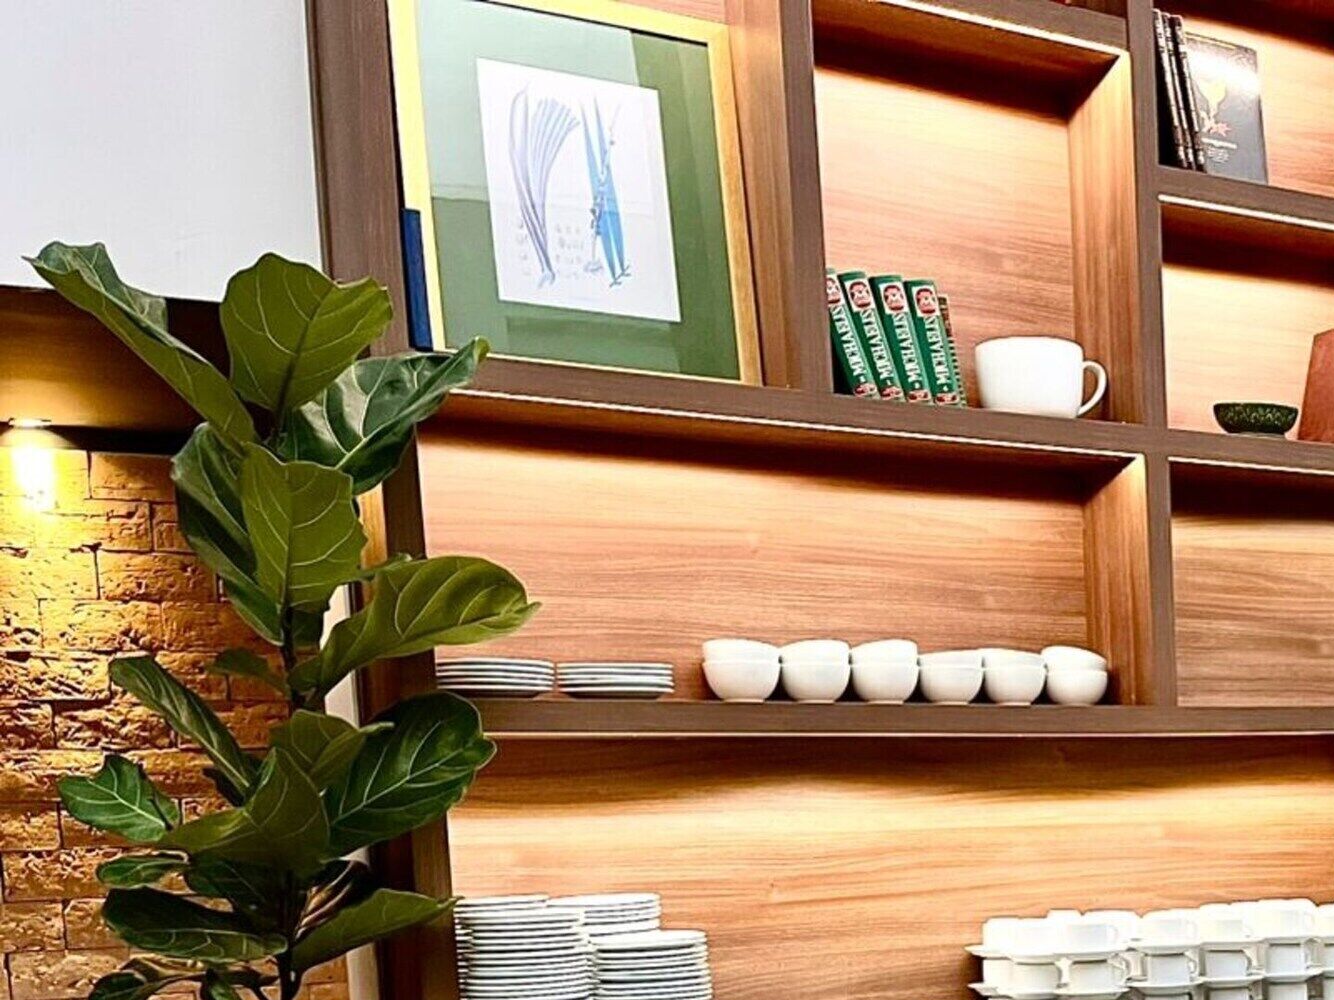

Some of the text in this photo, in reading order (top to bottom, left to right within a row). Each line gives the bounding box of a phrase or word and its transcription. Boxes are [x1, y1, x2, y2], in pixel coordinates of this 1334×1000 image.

[831, 305, 867, 376] MICHAELIS
[860, 309, 894, 380] MICHAELIS
[891, 312, 922, 383] MICHAELIS
[923, 315, 950, 385] MICHAELIS
